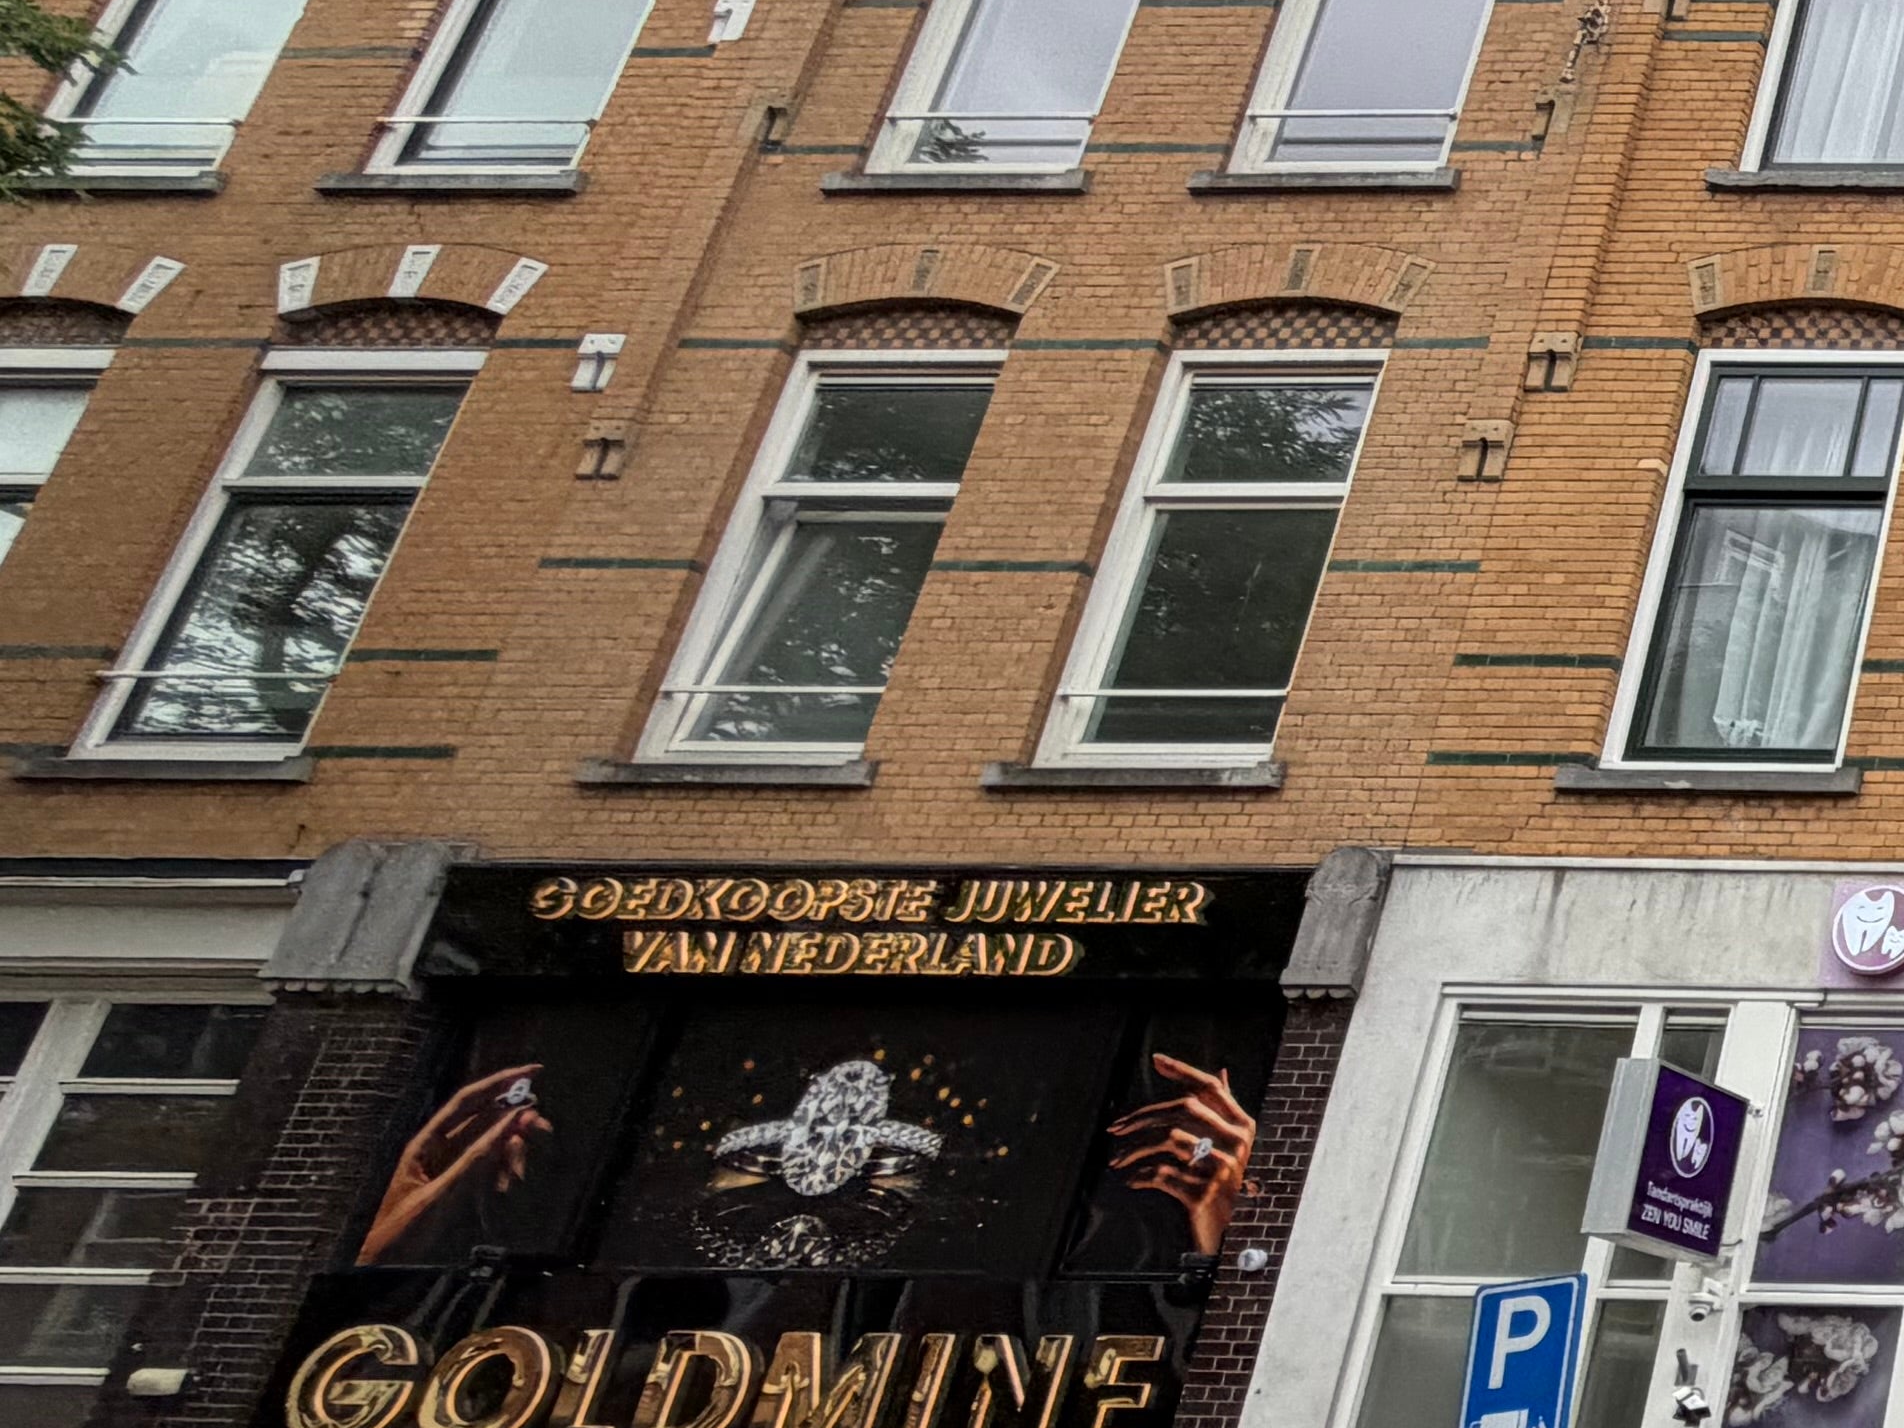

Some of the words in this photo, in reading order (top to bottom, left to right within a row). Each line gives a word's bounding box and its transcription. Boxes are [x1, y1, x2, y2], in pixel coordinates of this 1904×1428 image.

[530, 877, 937, 922] GOEDKOOPSTE
[944, 879, 1210, 923] JUWELER
[624, 930, 737, 974] VAN
[740, 930, 1080, 976] NEDERLAND
[1641, 1203, 1662, 1225] ZEN
[1663, 1210, 1682, 1232] YOU
[1682, 1217, 1711, 1240] SMILE
[1488, 1295, 1551, 1389] P
